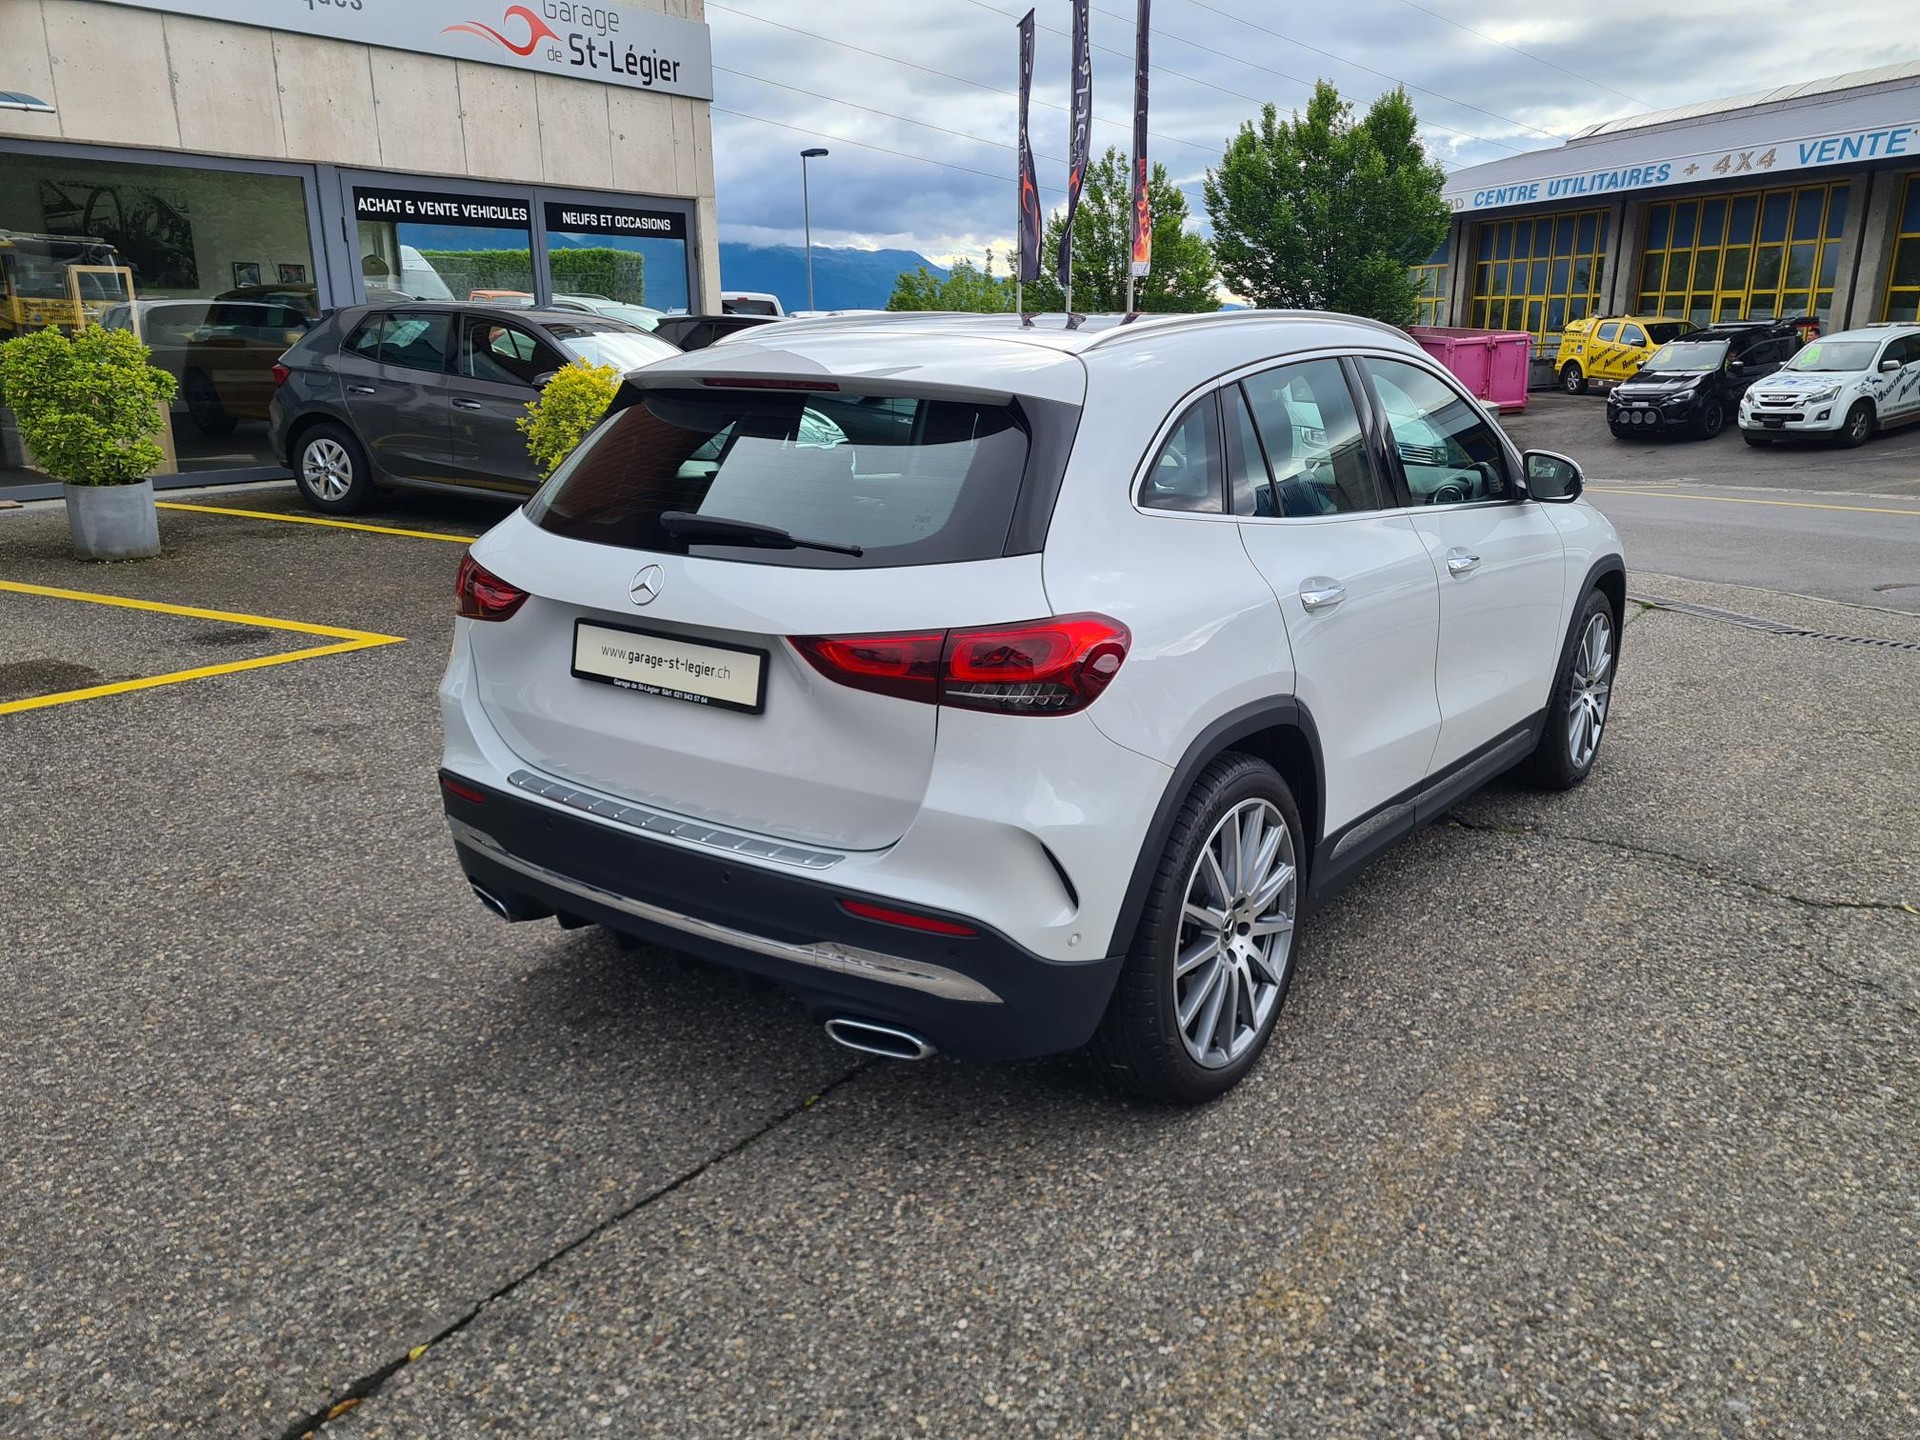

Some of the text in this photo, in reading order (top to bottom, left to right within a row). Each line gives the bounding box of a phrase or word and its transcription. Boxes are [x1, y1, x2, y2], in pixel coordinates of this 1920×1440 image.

[543, 0, 620, 37] Garage
[547, 33, 681, 86] de St-Légier
[1473, 183, 1538, 207] CENTRE
[1547, 163, 1672, 197] UTILITAIRES
[1712, 147, 1779, 174] 4X4
[1799, 128, 1912, 165] VENTE
[357, 197, 528, 221] ACHAT & VENTE VEHICULES
[562, 211, 671, 231] NEUFS ET OCCASIONS
[601, 645, 731, 680] www.garage-st-legier.ch
[613, 678, 630, 689] Garage
